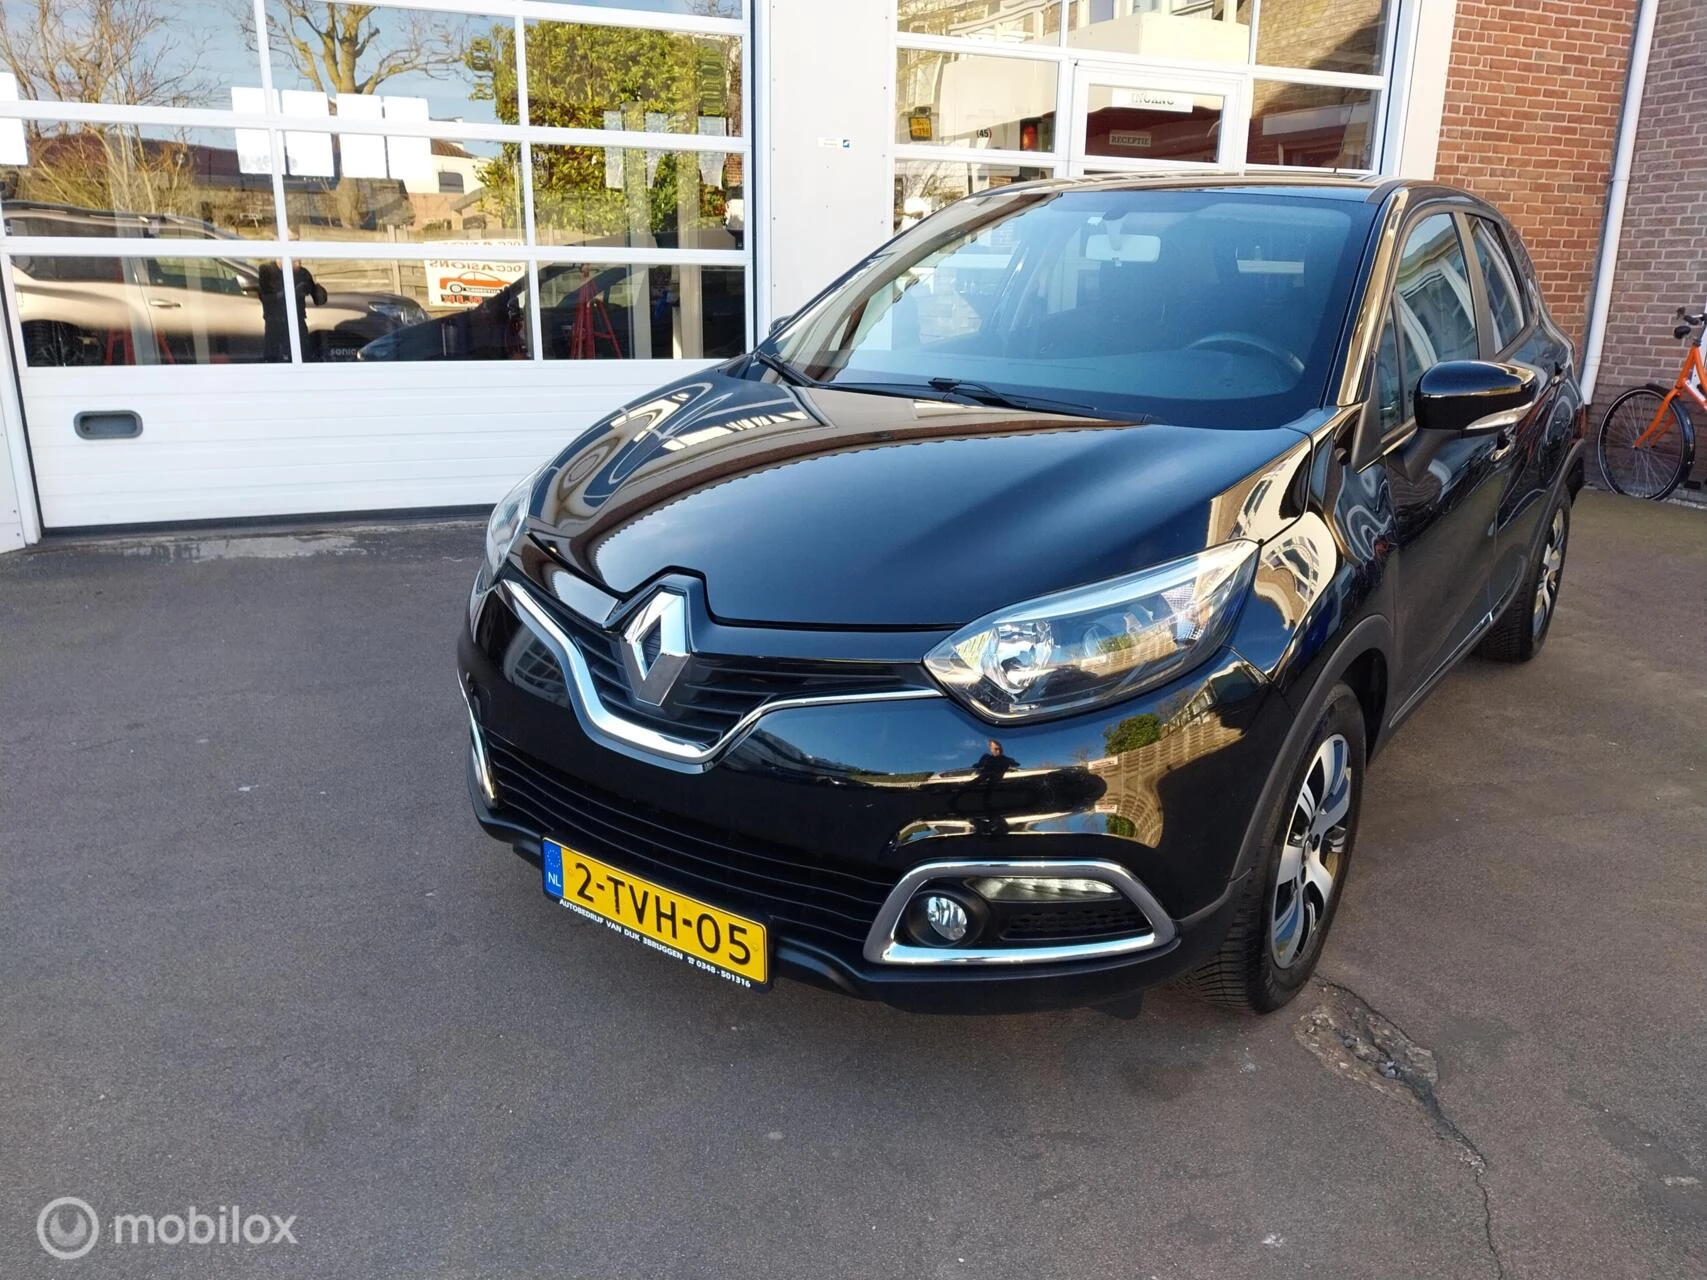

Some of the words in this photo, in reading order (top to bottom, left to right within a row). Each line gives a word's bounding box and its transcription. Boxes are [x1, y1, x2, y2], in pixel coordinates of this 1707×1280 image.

[1111, 135, 1150, 145] RECEPTIE
[547, 871, 562, 888] NL
[575, 862, 751, 966] 2-TVH-05
[559, 898, 604, 924] AUTOBEDRIJF
[605, 919, 622, 934] VAN
[623, 927, 641, 942] DIJK
[720, 969, 751, 988] 501316
